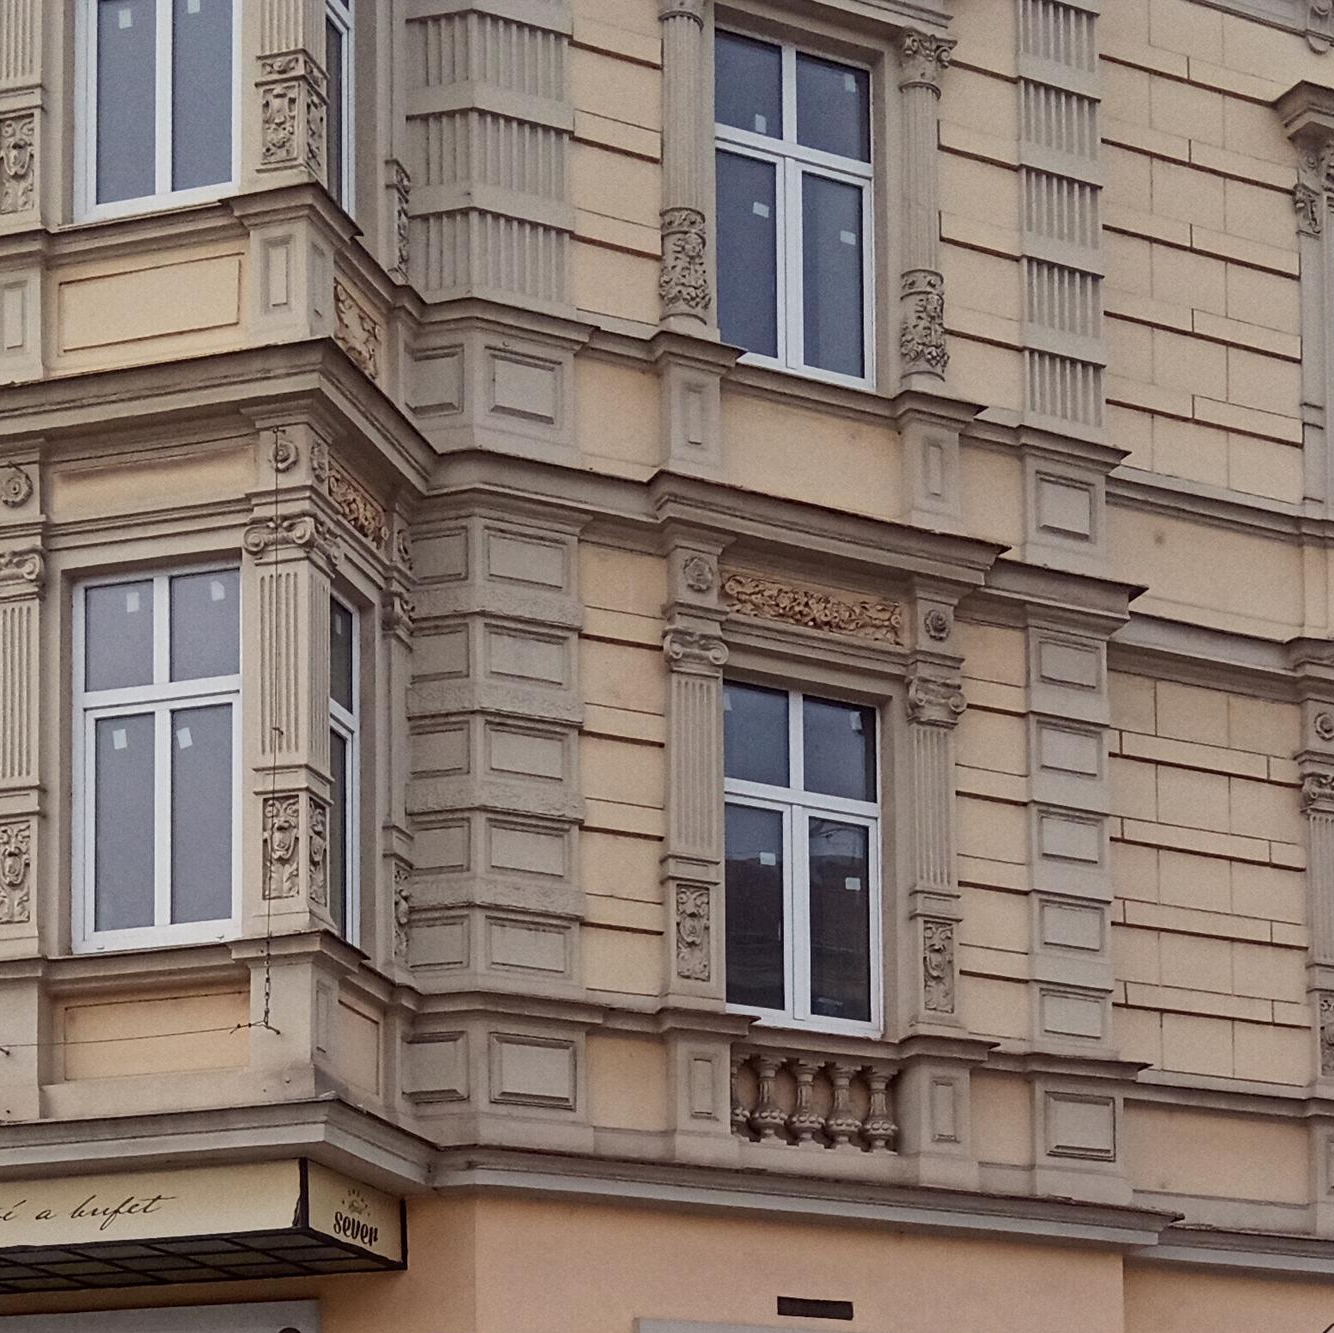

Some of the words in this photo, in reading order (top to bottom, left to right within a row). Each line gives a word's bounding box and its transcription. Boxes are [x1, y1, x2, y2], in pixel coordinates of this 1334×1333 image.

[34, 1208, 57, 1222] a
[70, 1194, 177, 1231] bufet
[333, 1211, 379, 1247] sever
